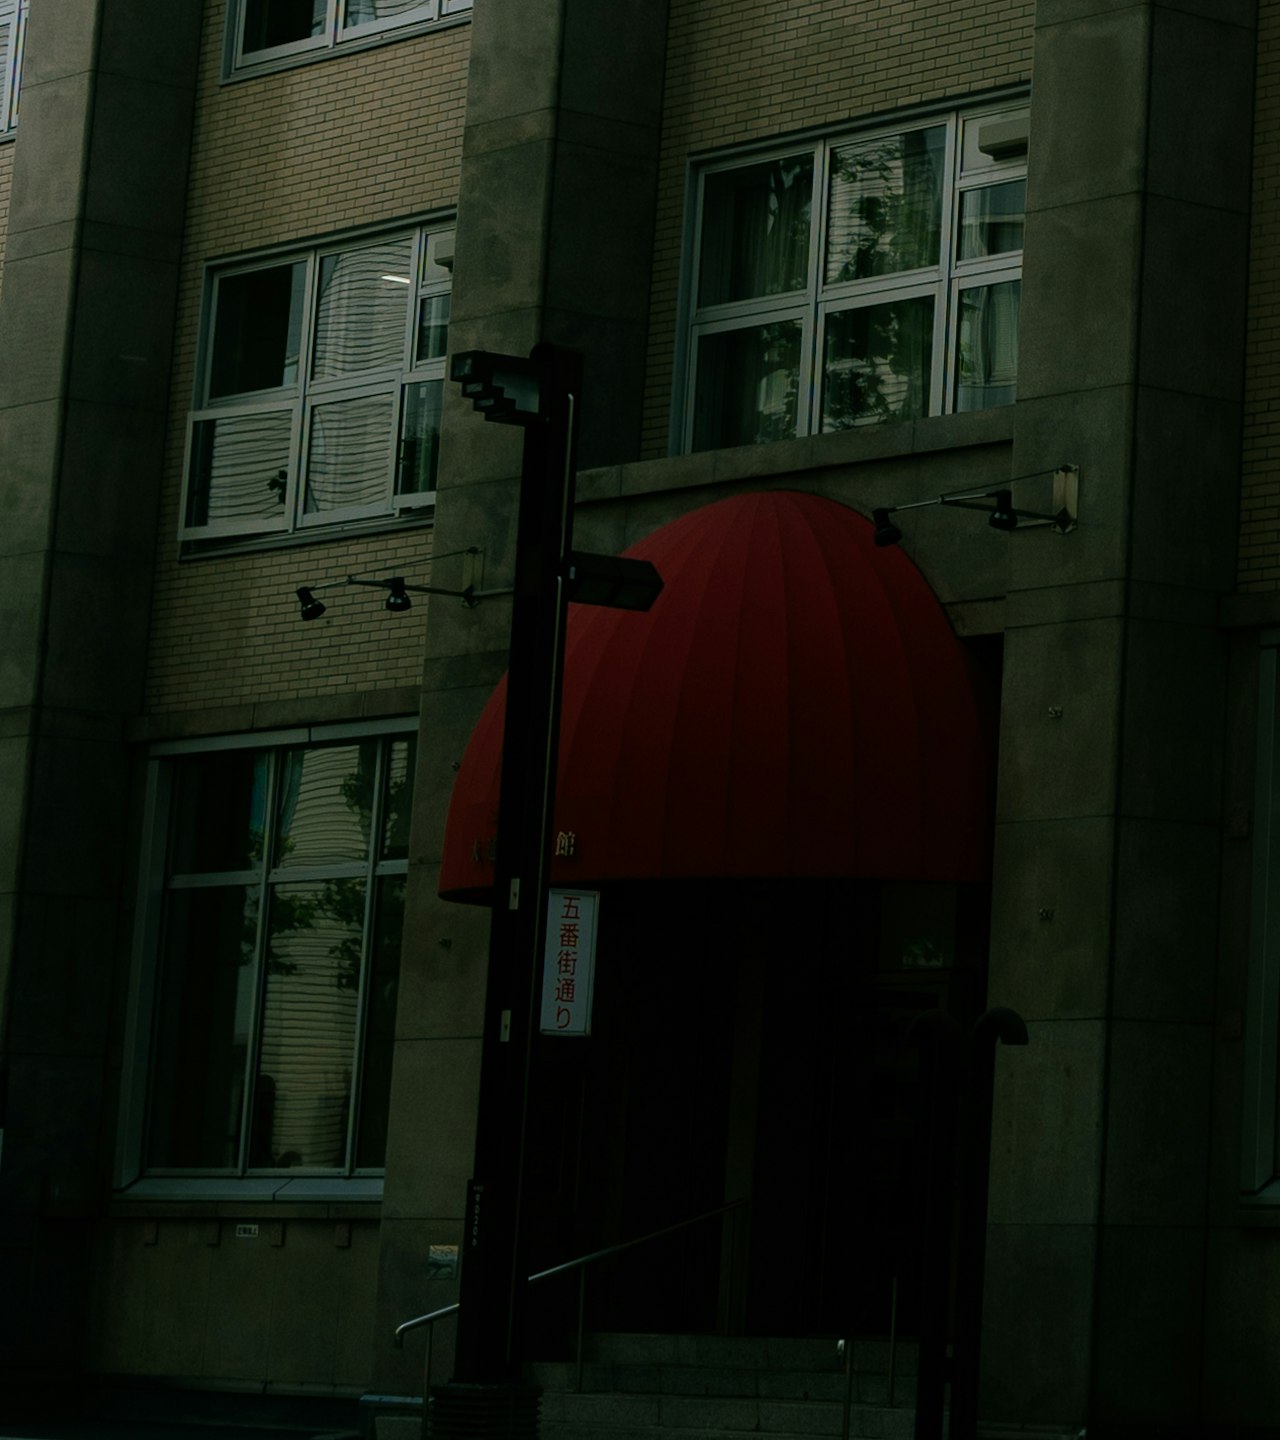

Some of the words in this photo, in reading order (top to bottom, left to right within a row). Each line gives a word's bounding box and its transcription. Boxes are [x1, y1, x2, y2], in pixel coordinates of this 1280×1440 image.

[555, 896, 581, 1029] 五番街通り
